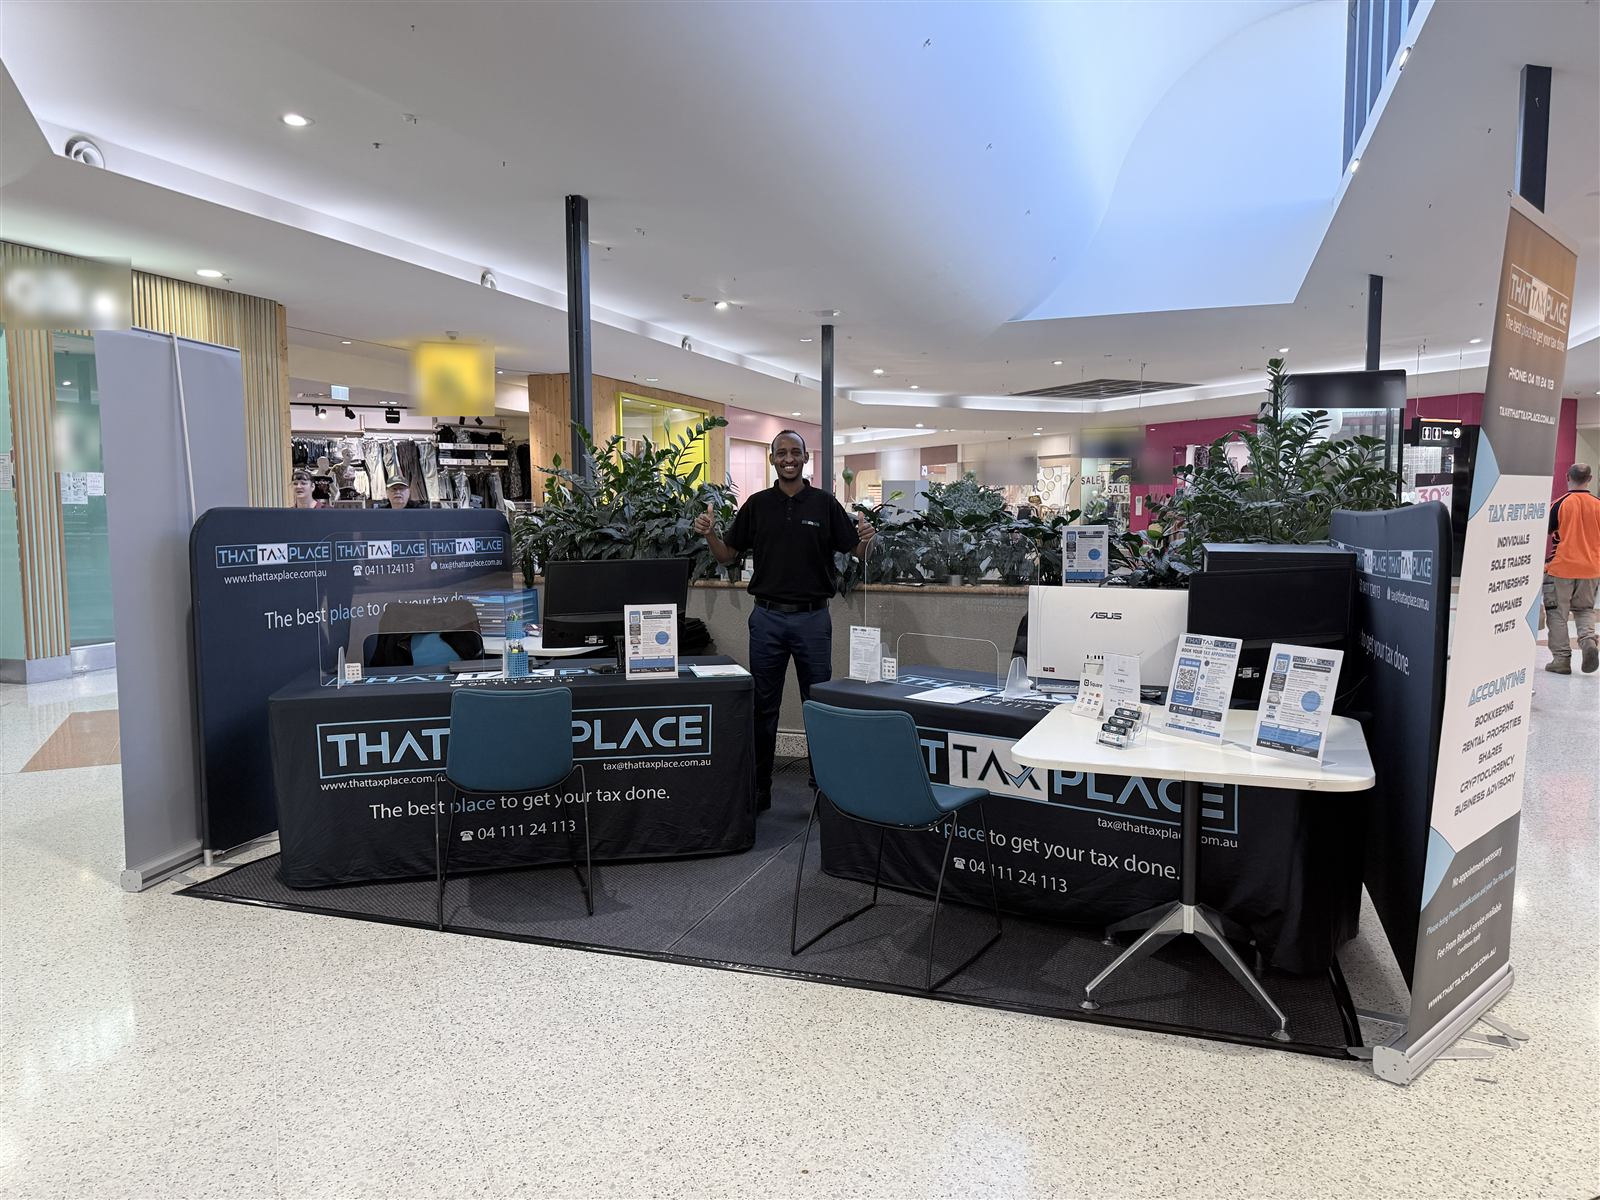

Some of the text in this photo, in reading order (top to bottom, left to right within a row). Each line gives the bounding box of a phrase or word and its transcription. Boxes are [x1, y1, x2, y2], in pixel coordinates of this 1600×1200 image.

[1510, 273, 1568, 327] THAT TAX PLACE
[1504, 313, 1514, 331] The
[1081, 476, 1100, 485] SALE
[1107, 485, 1129, 494] SALE
[1488, 502, 1546, 523] TAX RETURNS
[431, 540, 502, 553] THAT TAX PLACE
[1497, 533, 1530, 548] INDIVIDUALS
[218, 546, 329, 564] THAT TAX PLACE
[337, 543, 425, 557] THAT TAX PLACE
[365, 563, 415, 576] 0411 124113
[440, 559, 503, 570] tax@thattaxplace.com.au
[1412, 558, 1431, 577] PLACE
[1490, 555, 1531, 571] SOLE TRADERS
[224, 569, 327, 584] www.thattaxplace.com.au
[1488, 575, 1529, 593] PARTNERSHIPS
[1490, 597, 1522, 614] COMPANIES
[264, 611, 293, 629] The
[296, 608, 327, 626] best
[330, 604, 364, 625] place
[366, 602, 380, 616] to
[1090, 611, 1122, 620] ASUS
[1494, 619, 1516, 634] TRUSTS
[1186, 637, 1202, 645] THAT
[1215, 640, 1237, 649] PLACE
[1089, 681, 1103, 689] Square
[1468, 668, 1526, 707] ACCOUNTING
[1475, 700, 1514, 727] BOOKKEEPING
[326, 715, 703, 767] THAT PLACE
[1462, 716, 1522, 754] RENTAL PROPERTIES
[1478, 743, 1503, 764] SHARES
[603, 759, 711, 771] tax@thattaxplace.com.au
[1460, 755, 1515, 793] CRYPTOCURRENCY
[952, 743, 1042, 791] TAX
[1053, 768, 1225, 820] PLACE
[369, 785, 670, 820] The best place to get your tax done.
[1454, 772, 1516, 816] BUSINESS ADVISORY
[477, 820, 577, 840] 04 111 24 113
[944, 822, 985, 842] place
[989, 829, 1006, 847] to
[1011, 836, 1040, 854] get
[1043, 842, 1085, 862] your
[1089, 848, 1119, 869] tax
[1124, 854, 1181, 881] done.
[969, 858, 1068, 893] 04 111 24 113
[1458, 858, 1485, 885] appointment
